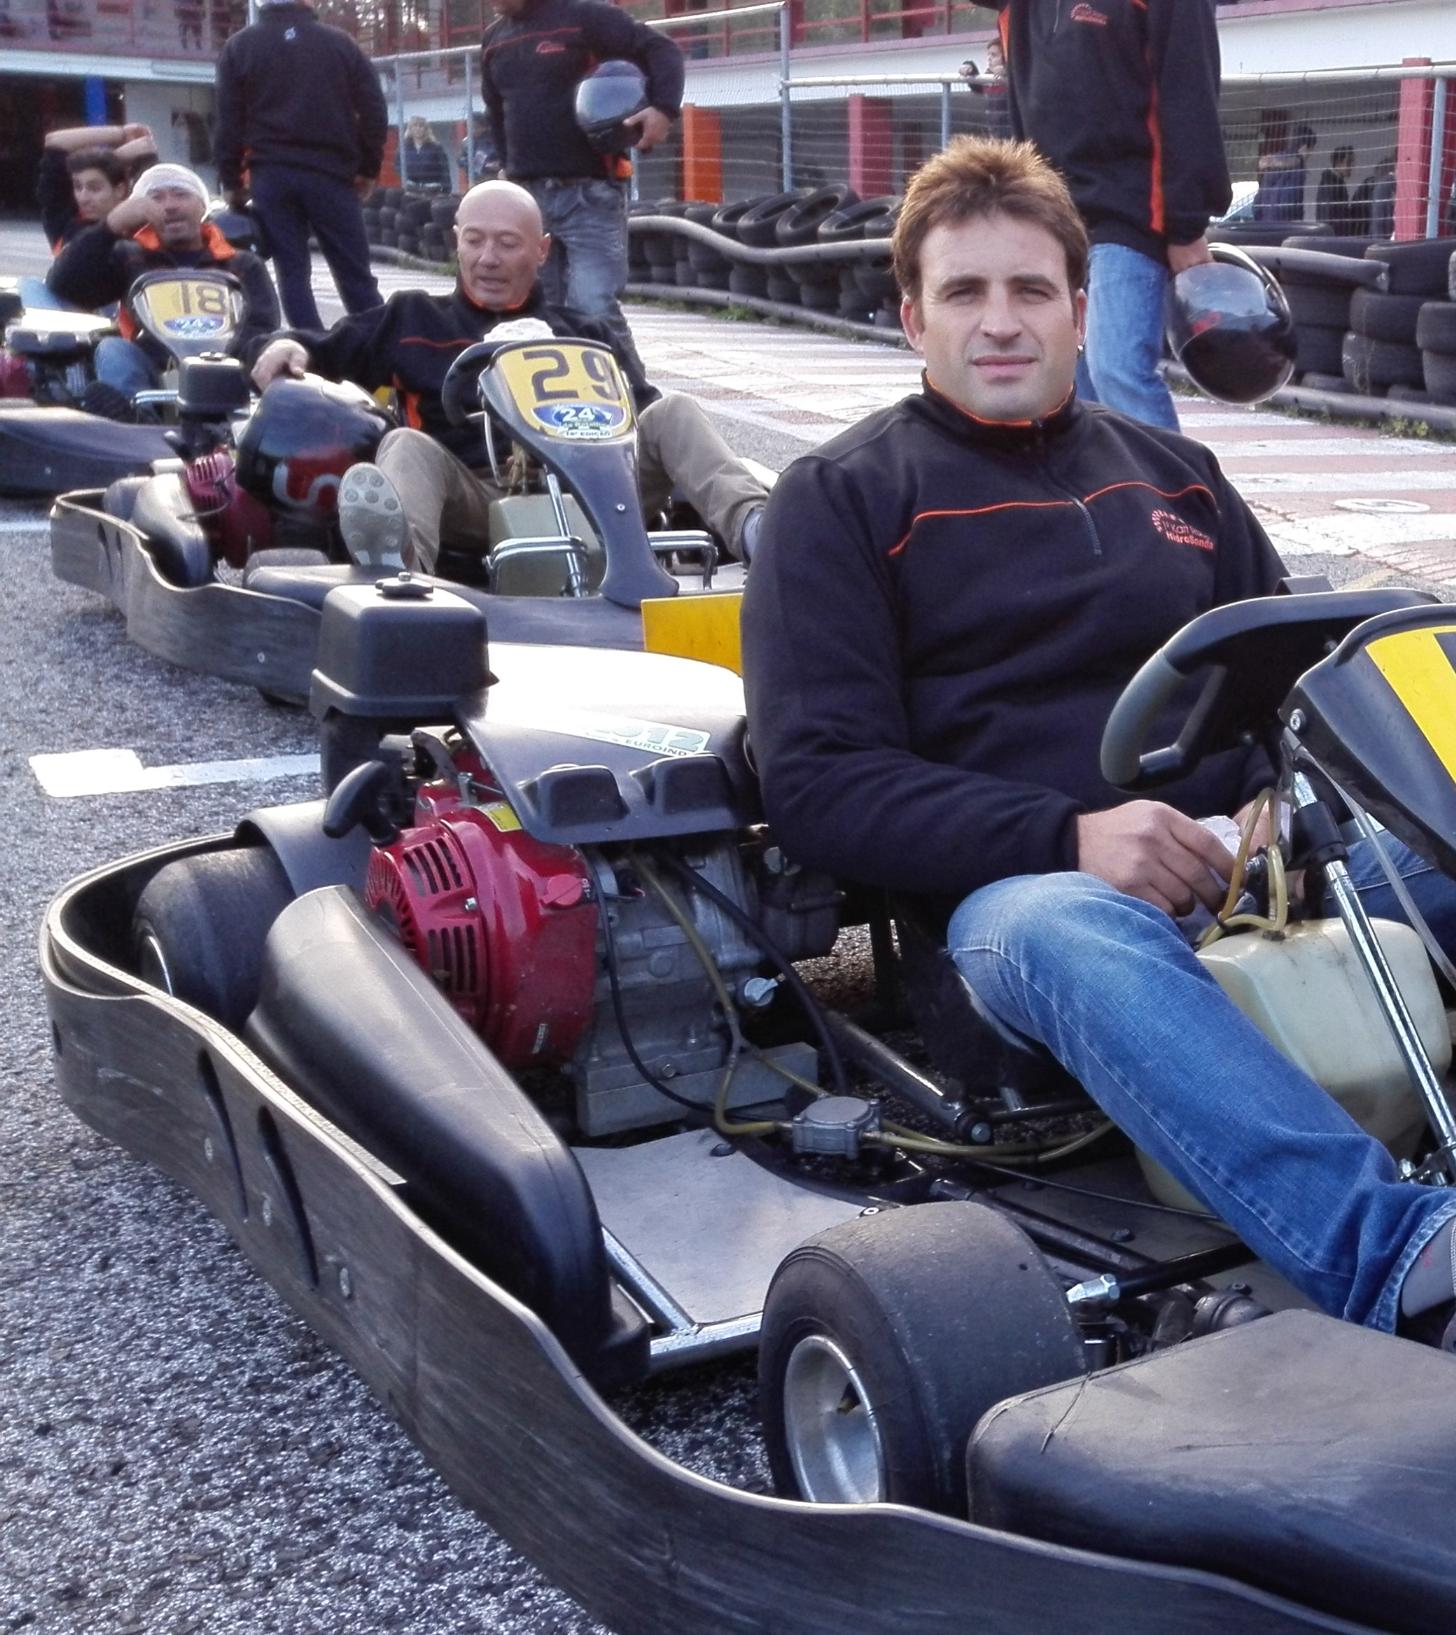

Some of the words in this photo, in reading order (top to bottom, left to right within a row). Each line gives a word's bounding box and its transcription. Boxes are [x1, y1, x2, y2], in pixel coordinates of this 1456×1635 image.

[181, 281, 228, 315] 18
[522, 349, 621, 402] 29
[560, 407, 596, 422] 24
